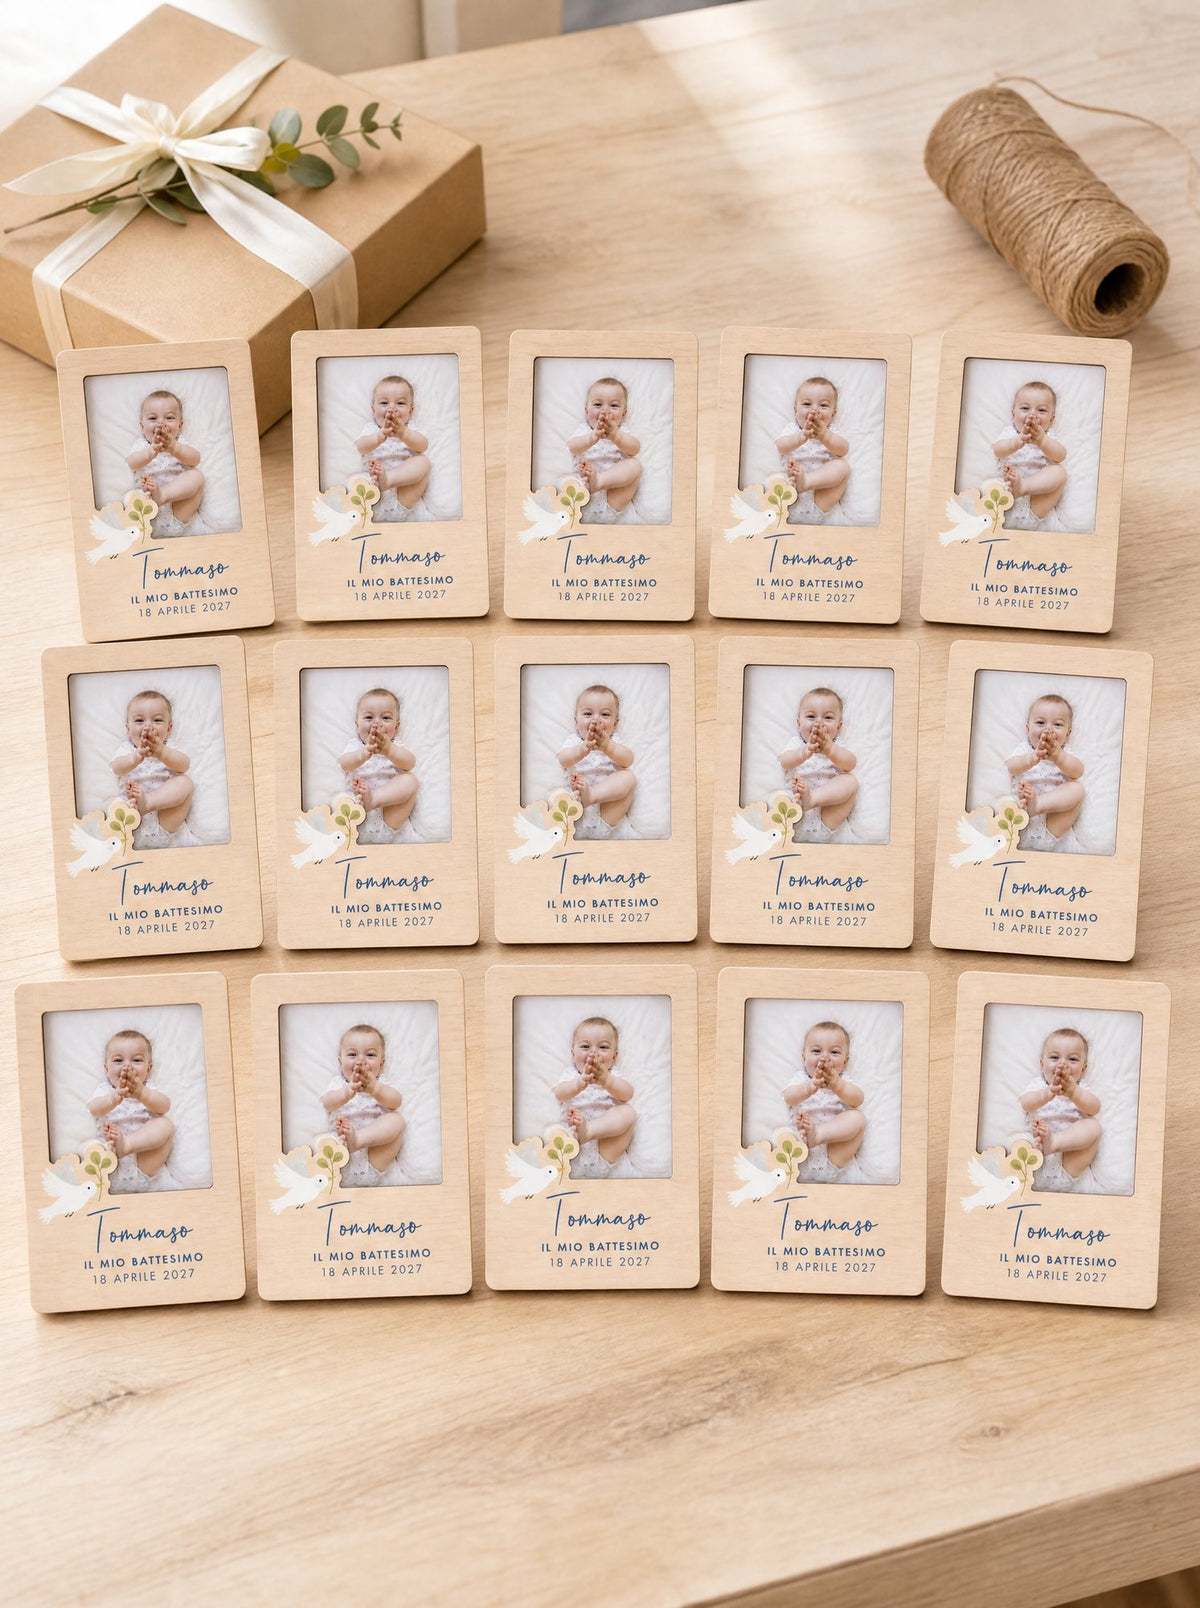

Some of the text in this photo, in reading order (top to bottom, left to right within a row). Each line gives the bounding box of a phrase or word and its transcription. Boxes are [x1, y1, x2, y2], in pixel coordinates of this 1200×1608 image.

[350, 532, 447, 575] Tommaso
[556, 533, 651, 574] Tommaso
[763, 532, 859, 574] Tommaso
[977, 538, 1073, 579] Tommaso
[131, 546, 229, 590] Tommaso
[347, 575, 454, 588] IL MIO BATTESIMO
[551, 578, 657, 588] IL MIO BATTESIMO
[756, 577, 864, 589] IL MIO BATTESIMO
[970, 582, 1079, 597] IL MIO BATTESIMO
[130, 586, 239, 605] IL MIO BATTESIMO
[354, 589, 446, 602] 18 APRILE 2027
[558, 591, 649, 602] 18 APRILE 2027
[763, 591, 856, 603] 18 APRILE 2027
[977, 596, 1070, 611] 18 APRILE 2027
[138, 600, 231, 618] 18 APRILE 2027
[334, 855, 435, 900] Tommaso
[551, 851, 652, 895] Tommaso
[768, 853, 869, 896] Tommaso
[111, 860, 215, 906] Tommaso
[992, 860, 1093, 903] Tommaso
[331, 901, 443, 914] IL MIO BATTESIMO
[547, 897, 659, 909] IL MIO BATTESIMO
[762, 901, 876, 912] IL MIO BATTESIMO
[108, 904, 223, 922] IL MIO BATTESIMO
[555, 912, 651, 924] 18 APRILE 2027
[770, 915, 867, 927] 18 APRILE 2027
[984, 907, 1098, 923] IL MIO BATTESIMO
[117, 919, 215, 936] 18 APRILE 2027
[339, 915, 434, 929] 18 APRILE 2027
[992, 921, 1089, 937] 18 APRILE 2027
[545, 1190, 652, 1237] Tommaso
[772, 1195, 879, 1241] Tommaso
[86, 1206, 194, 1254] Tommaso
[316, 1200, 422, 1247] Tommaso
[1006, 1203, 1112, 1248] Tommaso
[541, 1240, 660, 1253] IL MIO BATTESIMO
[767, 1246, 886, 1258] IL MIO BATTESIMO
[83, 1252, 204, 1270] IL MIO BATTESIMO
[313, 1247, 431, 1263] IL MIO BATTESIMO
[550, 1256, 651, 1268] 18 APRILE 2027
[999, 1252, 1117, 1268] IL MIO BATTESIMO
[321, 1263, 422, 1278] 18 APRILE 2027
[775, 1261, 876, 1273] 18 APRILE 2027
[93, 1268, 195, 1285] 18 APRILE 2027
[1007, 1268, 1107, 1283] 18 APRILE 2027
